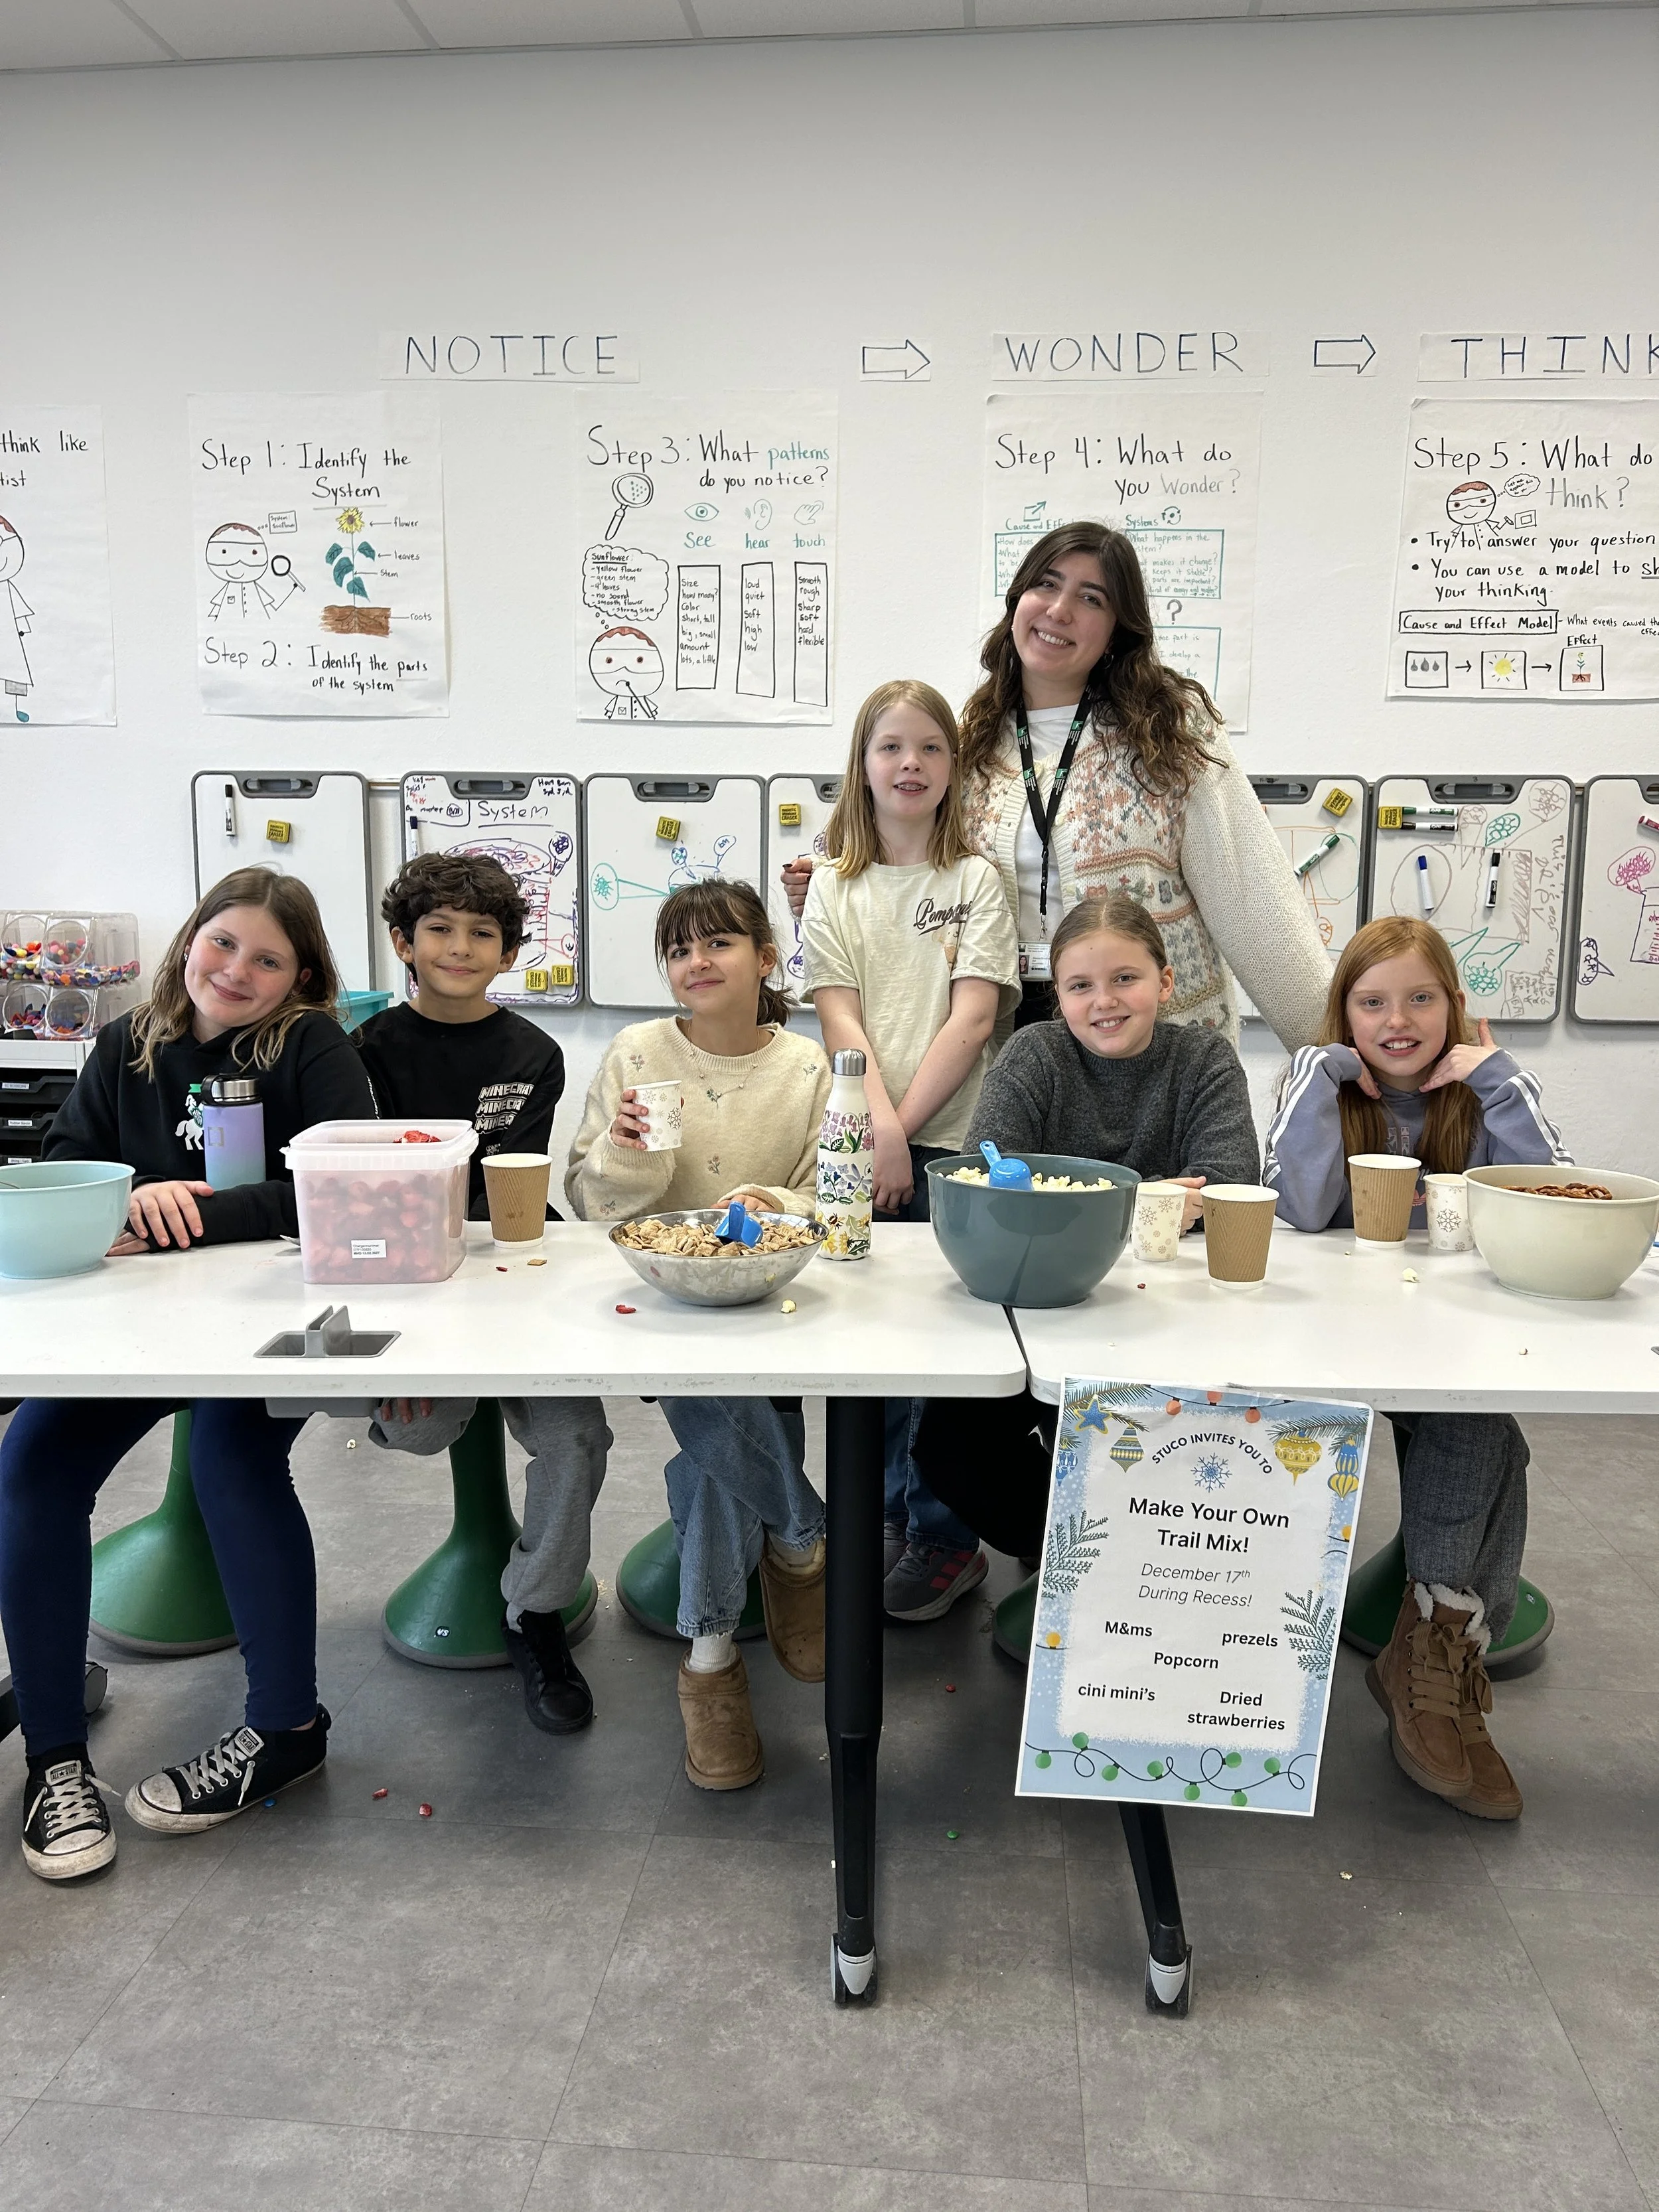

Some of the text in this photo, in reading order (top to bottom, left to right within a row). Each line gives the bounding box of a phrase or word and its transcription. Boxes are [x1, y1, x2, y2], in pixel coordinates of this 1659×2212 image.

[405, 334, 618, 376] NOTICE
[1005, 331, 1243, 373] WONDER
[1451, 334, 1659, 379] THINK
[0, 430, 90, 453] think like
[587, 425, 830, 473] Step 3: What patterns
[202, 439, 252, 475] Step
[297, 442, 367, 479] Identify
[384, 448, 412, 467] the
[995, 433, 1232, 475] Step 4: What do
[1413, 435, 1653, 475] Step 5: What do
[699, 466, 829, 494] do you notice?
[312, 476, 381, 506] System
[1114, 479, 1150, 505] you
[1545, 477, 1630, 510] think?
[394, 518, 419, 528] flower
[1005, 518, 1031, 531] Cause
[745, 532, 771, 550] hear
[792, 532, 826, 548] touch
[1000, 536, 1034, 546] How does
[1186, 532, 1192, 542] in
[1425, 530, 1656, 555] Try to answer your question
[394, 550, 421, 561] leaves
[1431, 558, 1630, 579] You can use a model to
[596, 574, 636, 585] green stem
[745, 578, 760, 589] loud
[1152, 577, 1167, 585] parts
[745, 591, 766, 605] quiet
[799, 587, 820, 602] rough
[1435, 585, 1467, 603] your
[409, 612, 433, 622] roots
[703, 613, 716, 623] tall
[1403, 614, 1553, 630] Cause and Effect Model
[1567, 613, 1646, 627] What events caused
[699, 630, 717, 640] small
[744, 621, 763, 641] high
[798, 623, 814, 634] hard
[1173, 633, 1188, 642] part
[680, 642, 710, 651] amount
[744, 640, 758, 652] low
[798, 634, 826, 646] flexible
[1567, 634, 1599, 648] Effect
[204, 636, 428, 678] Step 2: Identify the parts
[312, 676, 395, 696] of the system
[1151, 1432, 1273, 1475] STUCO INVITES YOU TO
[1129, 1497, 1290, 1530] Make Your Own
[1157, 1528, 1250, 1554] Trail Mix!
[1141, 1562, 1252, 1585] December 17th
[1138, 1584, 1253, 1607] During Recess!
[1104, 1620, 1153, 1637] M&ms
[1221, 1629, 1279, 1650] prezels
[1153, 1651, 1220, 1671] Popcorn
[1078, 1682, 1107, 1699] cini
[1219, 1690, 1263, 1708] Dried
[1187, 1710, 1286, 1731] strawberries
